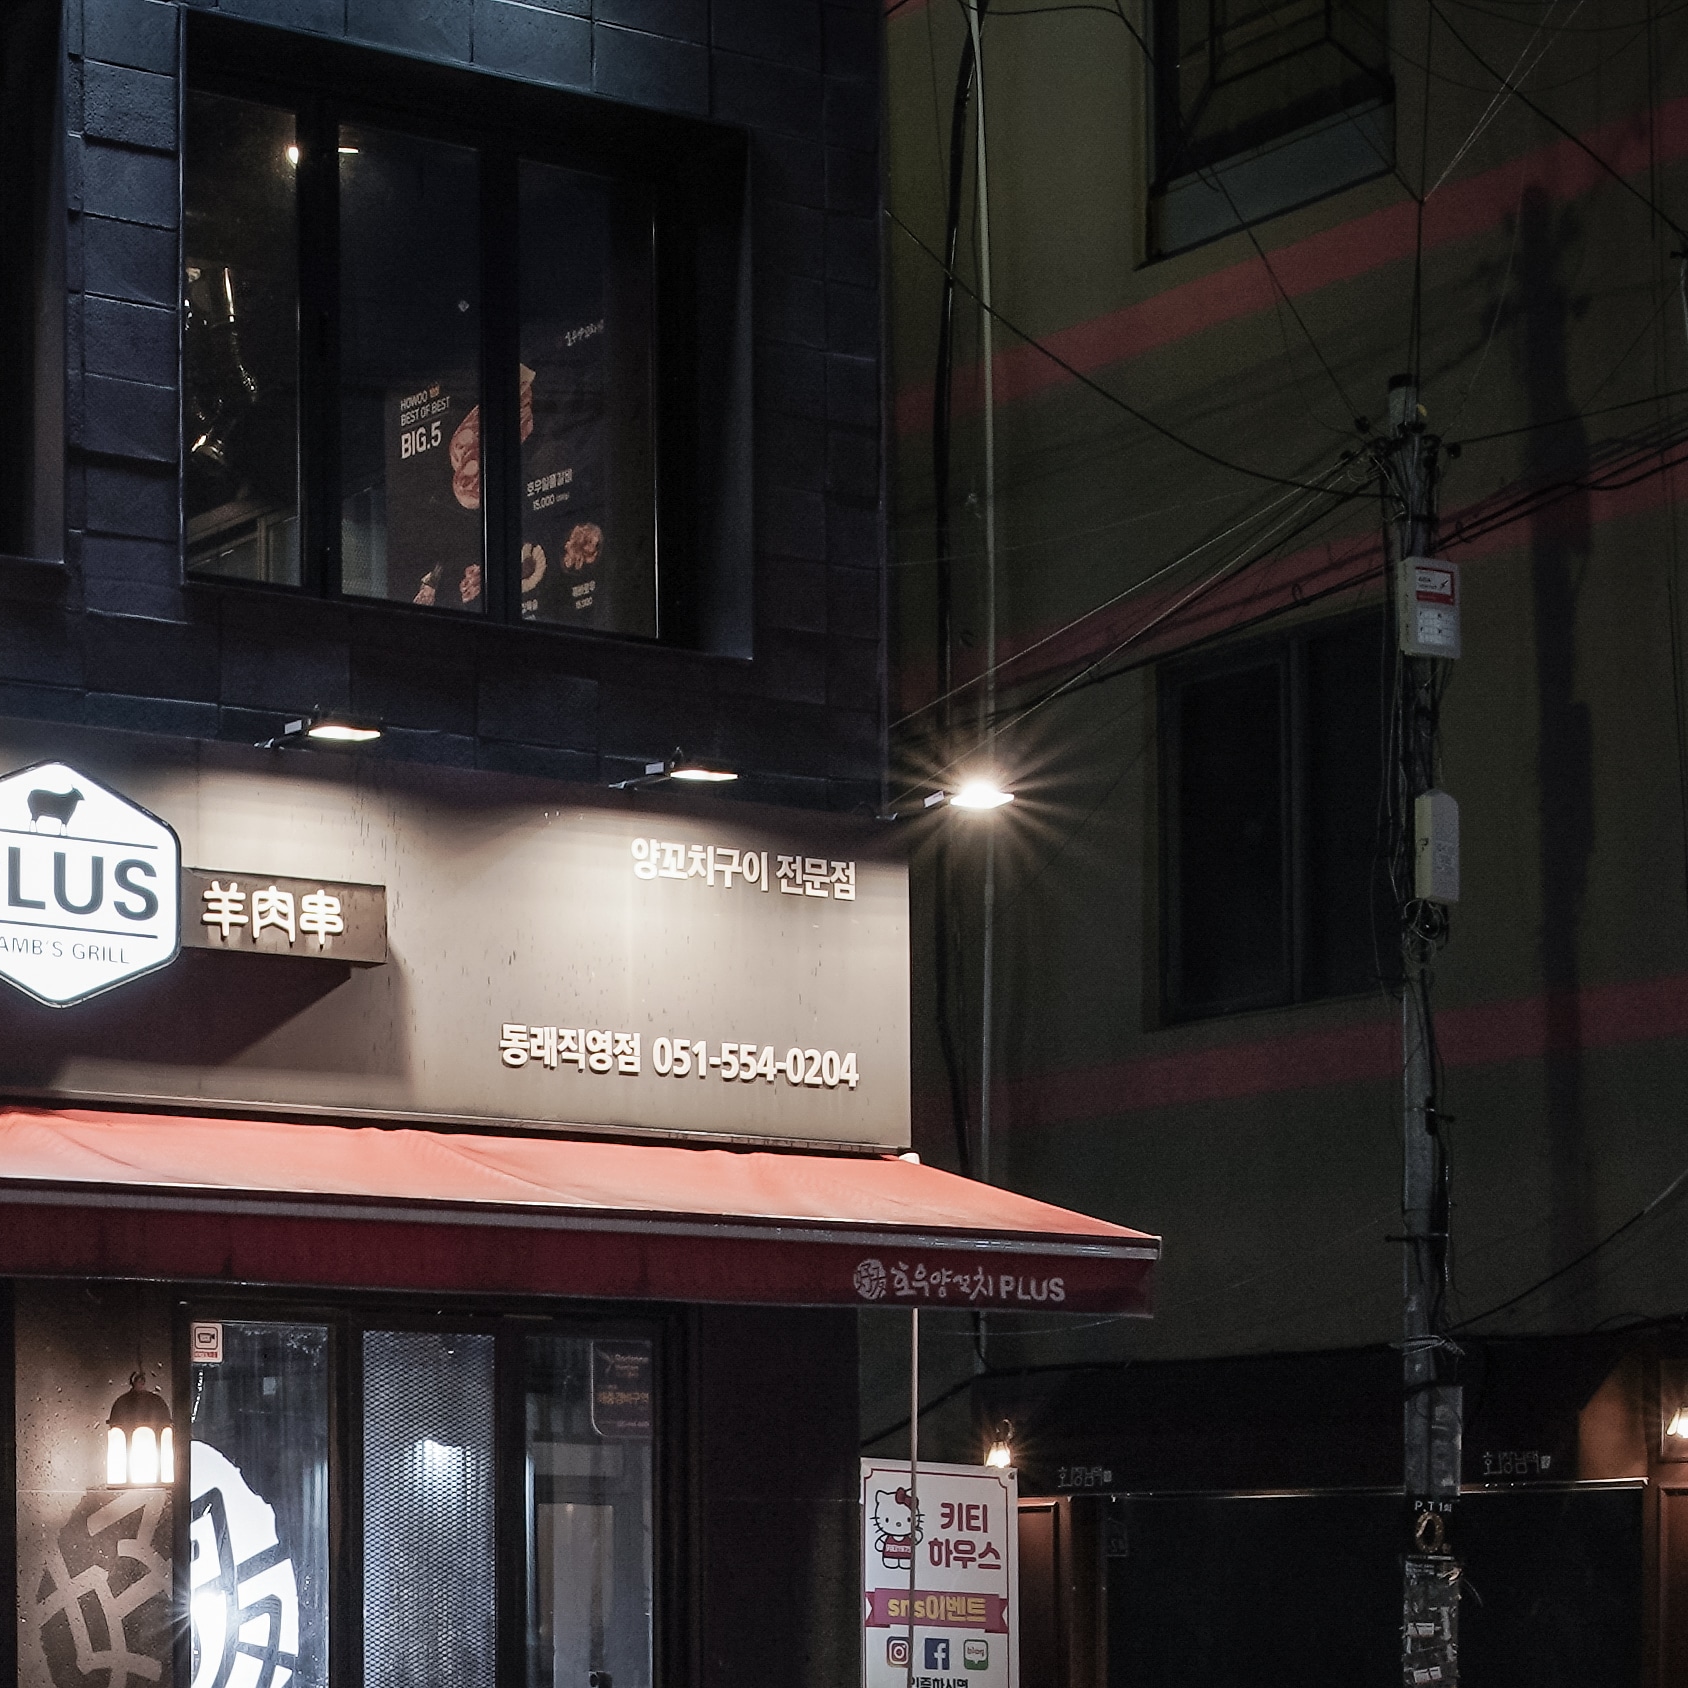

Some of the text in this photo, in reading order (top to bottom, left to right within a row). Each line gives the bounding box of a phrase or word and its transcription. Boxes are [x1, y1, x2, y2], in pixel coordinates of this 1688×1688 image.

[400, 407, 420, 427] BEST
[431, 395, 451, 415] BEST
[400, 420, 442, 459] BIG.5
[630, 836, 857, 901] 양꼬치구이 전문점
[200, 880, 345, 947] 羊肉串
[71, 940, 131, 966] GRILL
[499, 1022, 861, 1090] 동래직영점 051-554-0204
[891, 1261, 1066, 1302] 호우양꼬치 PLUS
[939, 1502, 989, 1533] 키티
[928, 1537, 1002, 1571] 하우스
[887, 1594, 987, 1623] sns이벤트
